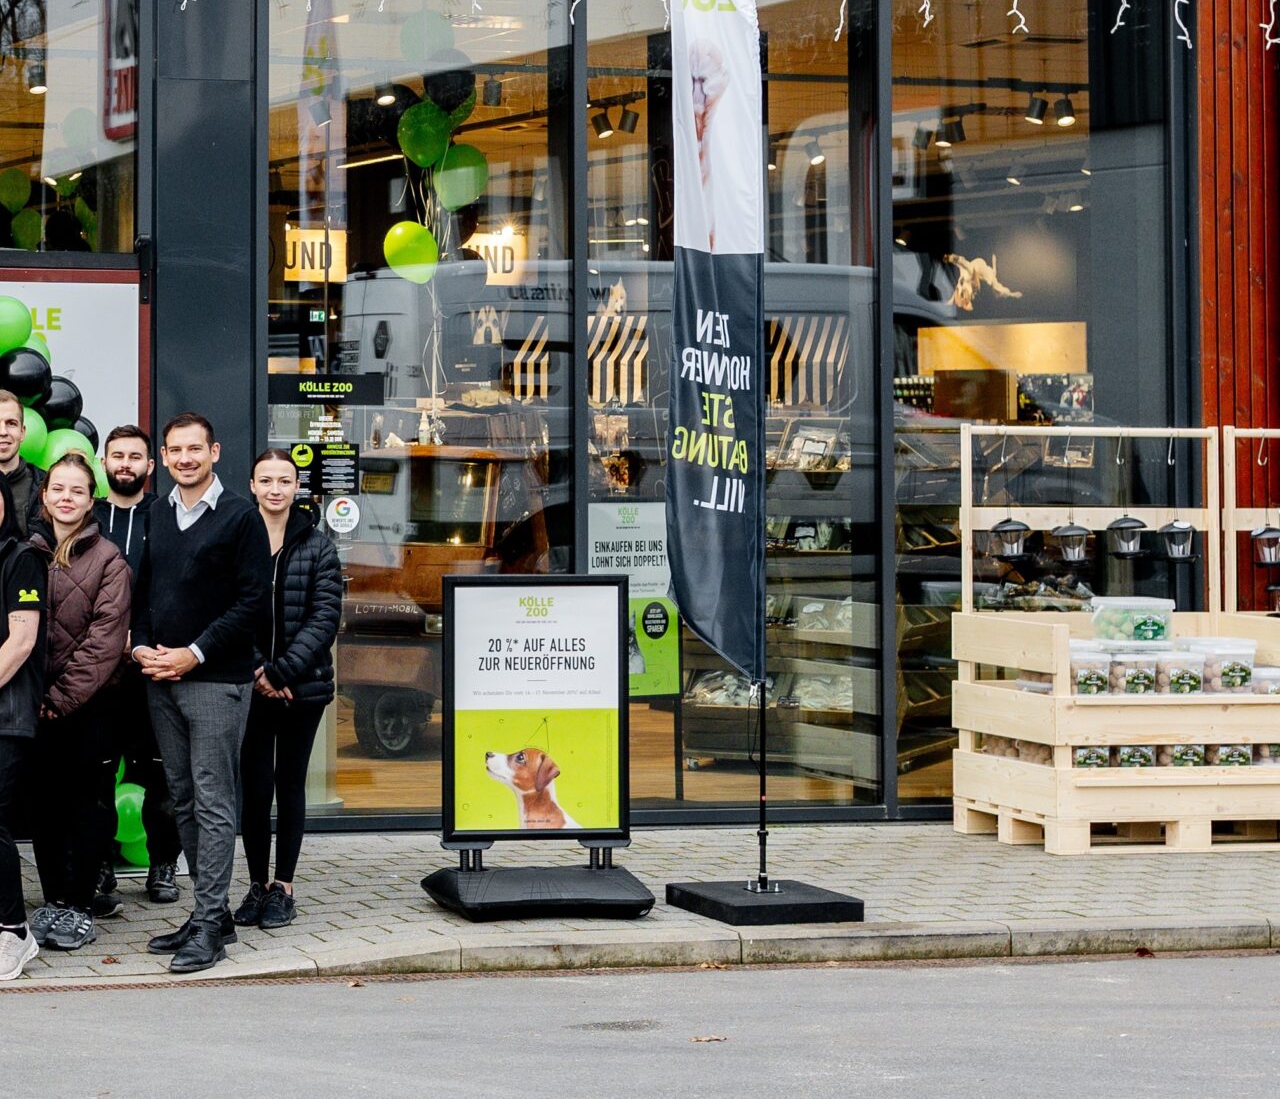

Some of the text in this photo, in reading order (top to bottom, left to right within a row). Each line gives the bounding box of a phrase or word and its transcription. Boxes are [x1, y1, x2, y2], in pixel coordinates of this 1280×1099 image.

[468, 245, 514, 274] ND
[299, 381, 353, 392] KÖLLE ZOO
[618, 506, 639, 516] KÖLLE
[621, 516, 636, 524] ZOO
[594, 540, 663, 553] EINKAUFEN BEI UNS
[591, 554, 667, 568] LOHNT SICH DOPPELT!
[519, 595, 555, 607] KÖLLE
[355, 604, 419, 614] LOTTI-MOBIL
[525, 607, 548, 617] ZOO
[488, 638, 502, 652] 20
[523, 638, 545, 652] AUF
[550, 638, 586, 652] ALLES
[478, 654, 595, 671] ZUR NEUERÖFFNUNG
